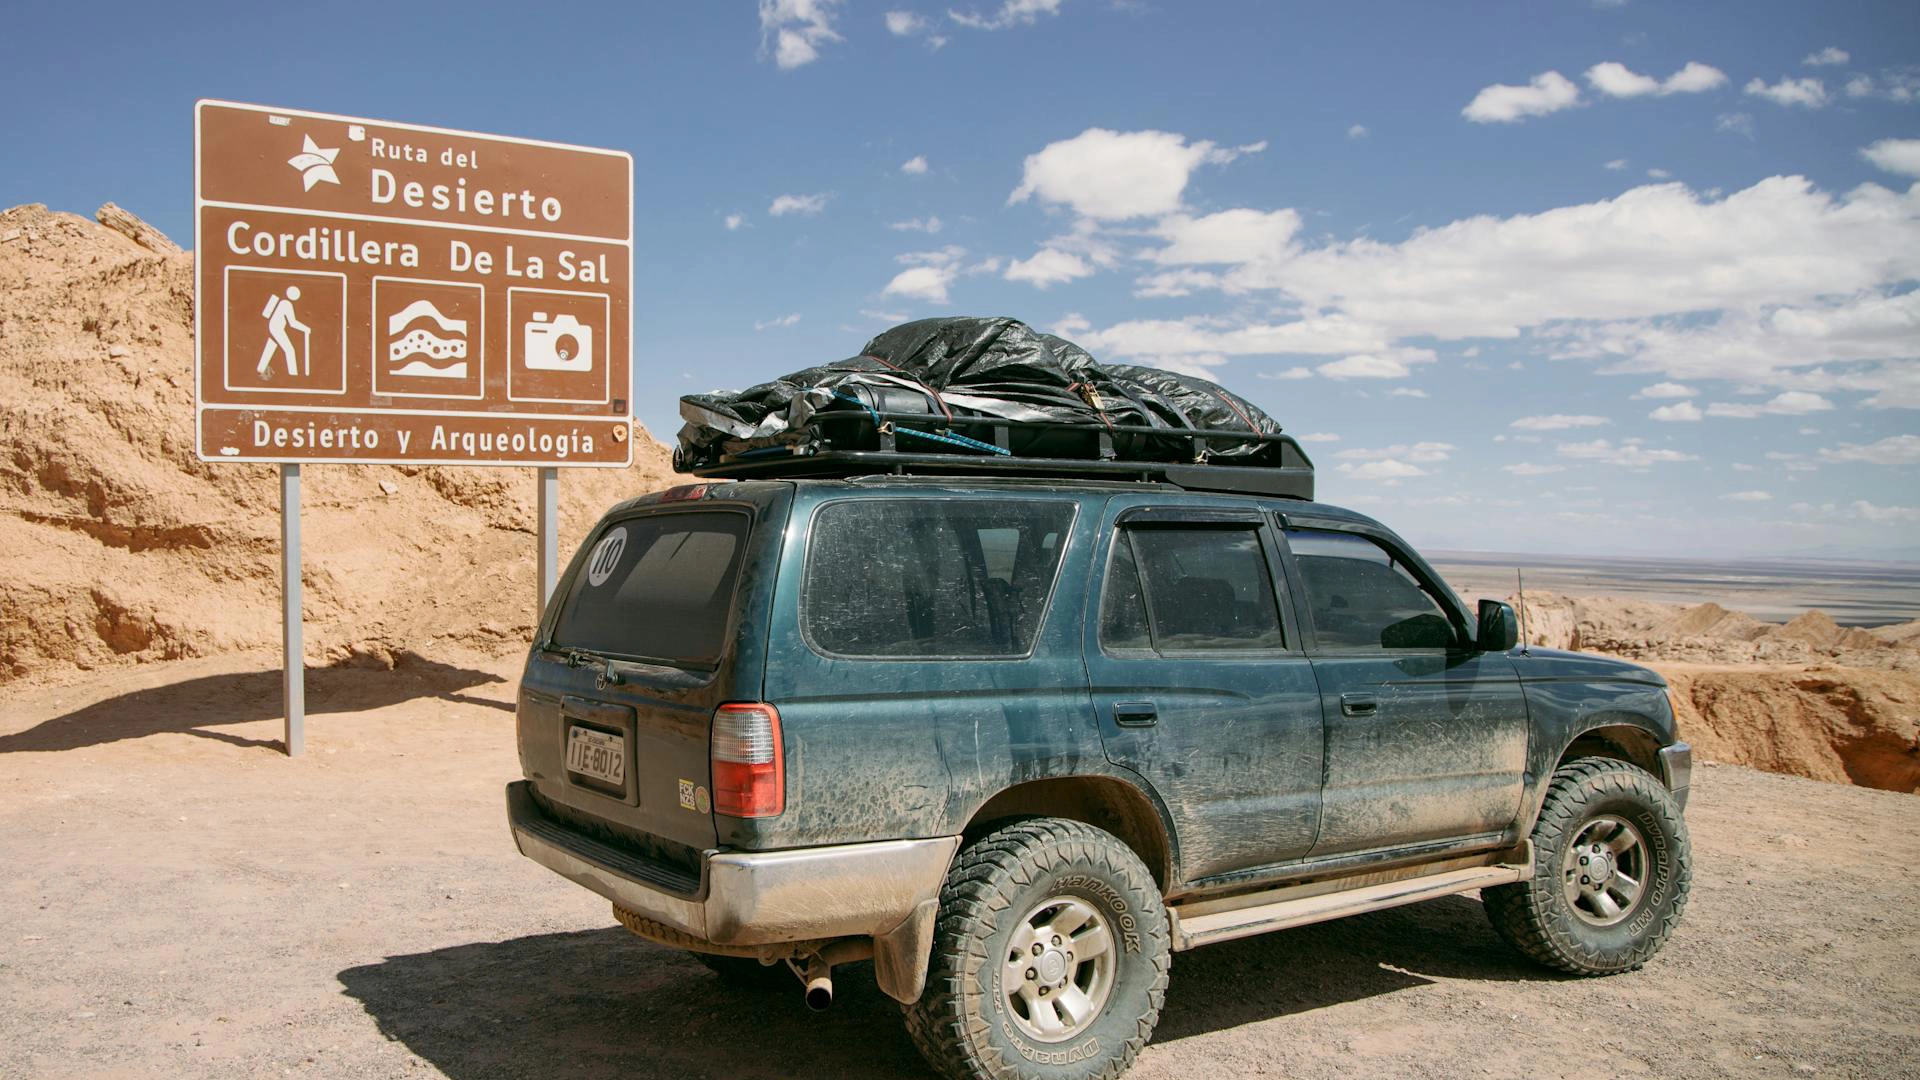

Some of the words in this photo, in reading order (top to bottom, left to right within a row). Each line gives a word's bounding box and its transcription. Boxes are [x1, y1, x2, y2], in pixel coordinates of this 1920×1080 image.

[371, 137, 428, 163] Ruta
[440, 147, 478, 169] del
[371, 168, 563, 222] Desierto
[226, 221, 420, 268] Cordillera
[450, 240, 493, 275] De
[506, 245, 544, 280] La
[557, 251, 610, 284] Sal
[253, 419, 379, 450] Desierto
[396, 430, 411, 453] y
[431, 424, 595, 458] Arqueología
[679, 782, 694, 796] FCK
[1627, 907, 1655, 938] MT
